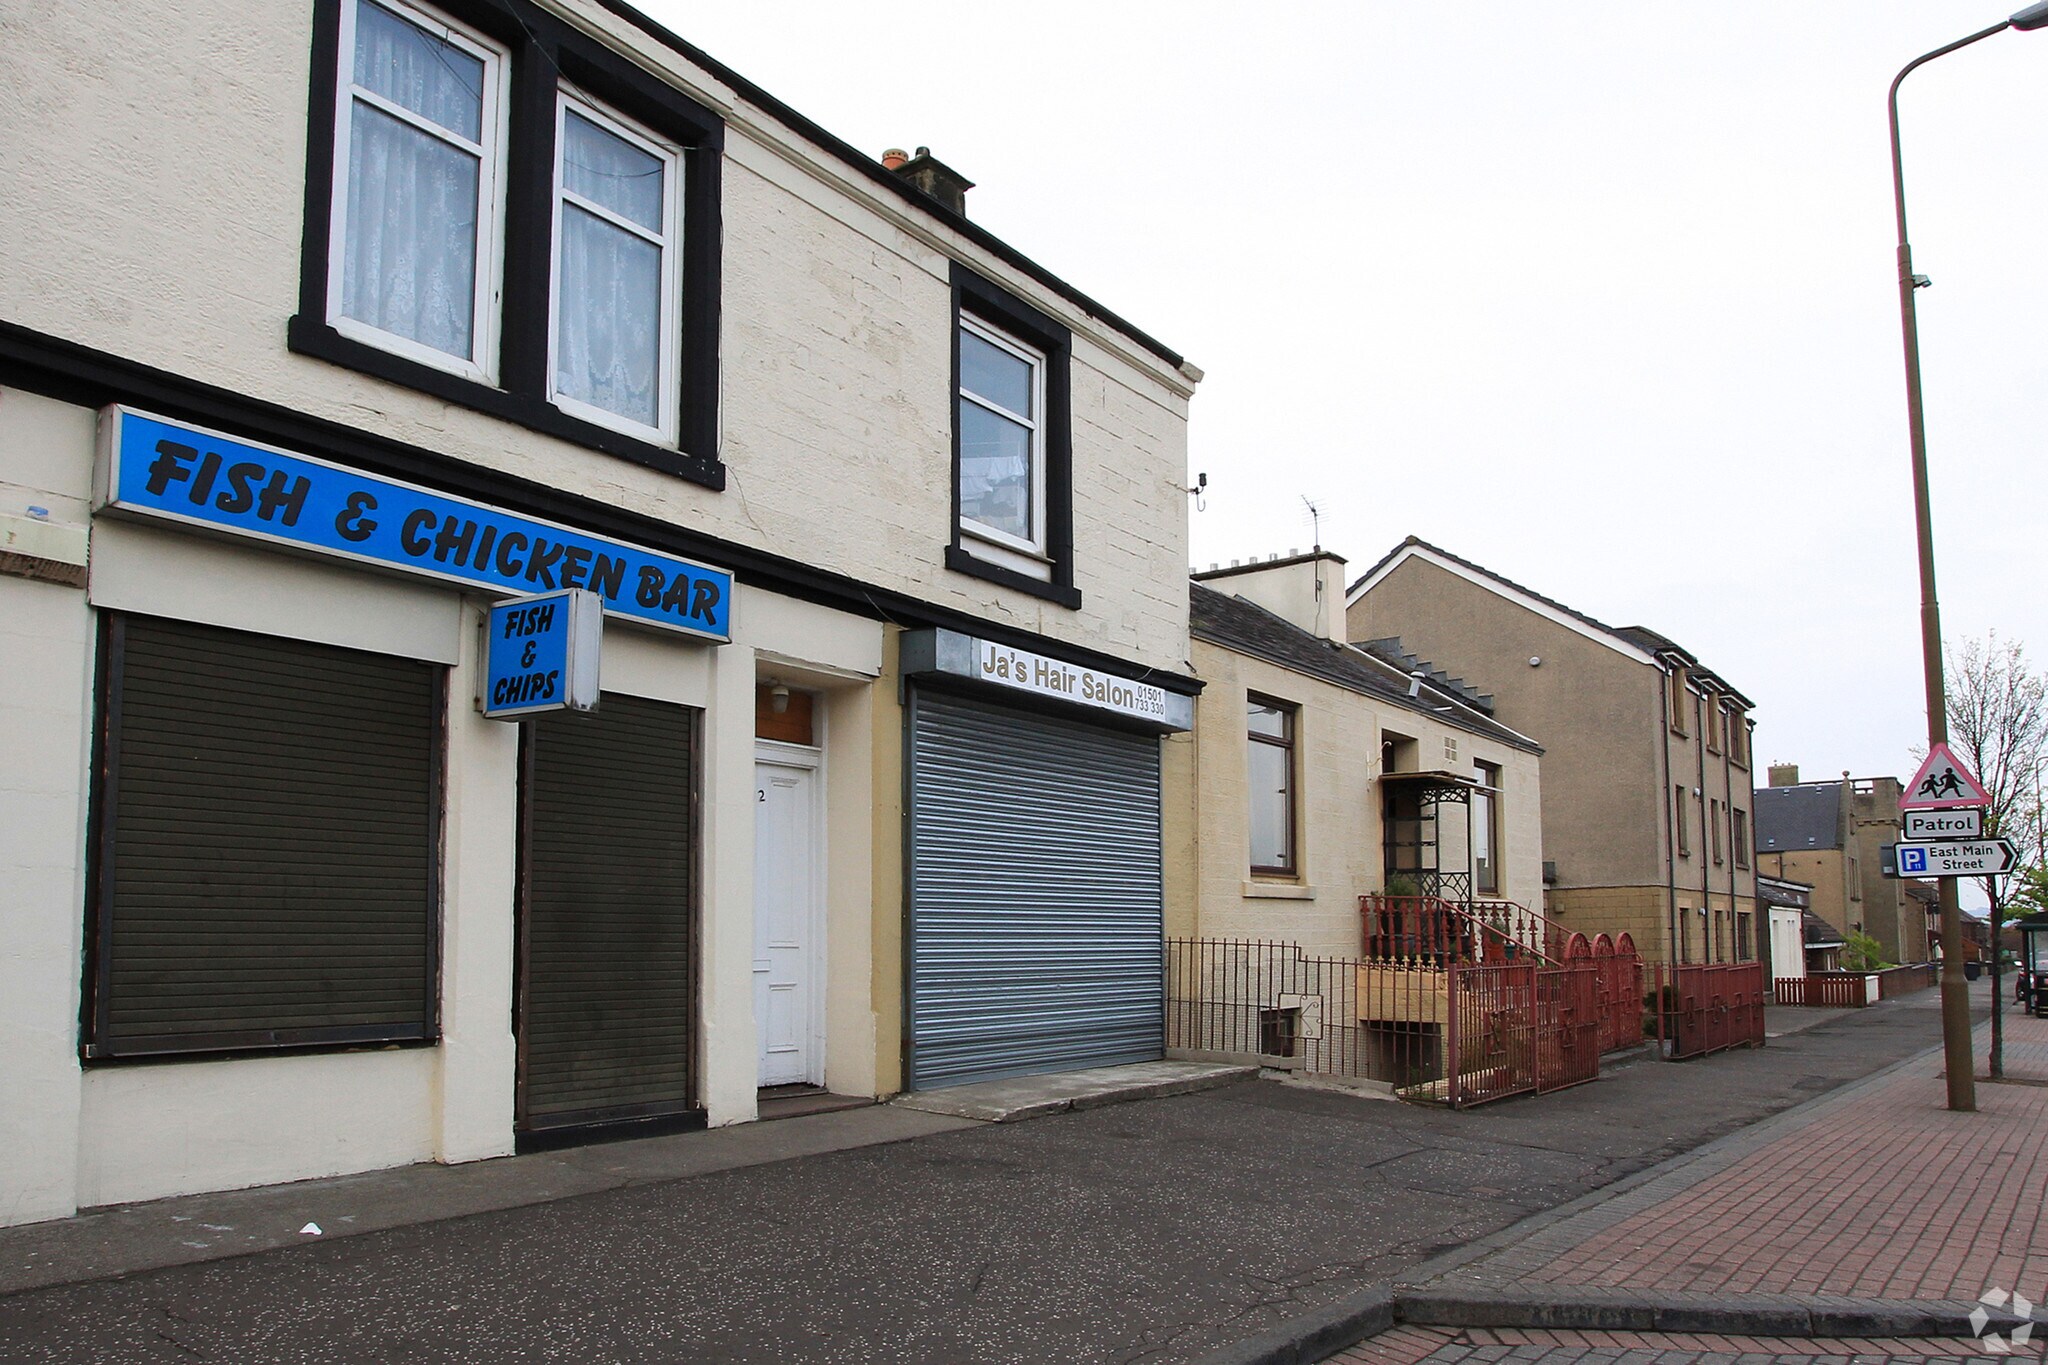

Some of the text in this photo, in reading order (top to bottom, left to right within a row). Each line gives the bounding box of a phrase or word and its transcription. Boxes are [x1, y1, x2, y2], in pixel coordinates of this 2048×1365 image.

[145, 439, 720, 626] FISH & CHICKEN BAR
[504, 604, 554, 639] FISH
[520, 640, 536, 669] &
[982, 646, 1134, 709] Ja's Hair Salon
[493, 670, 559, 706] CHIPS
[1137, 685, 1162, 702] 01501
[1135, 699, 1165, 715] 733 330
[757, 789, 766, 802] 2
[1913, 817, 1973, 831] Patrol
[1904, 851, 1920, 870] P
[1929, 845, 1994, 858] East Main
[1942, 859, 1984, 870] Street
